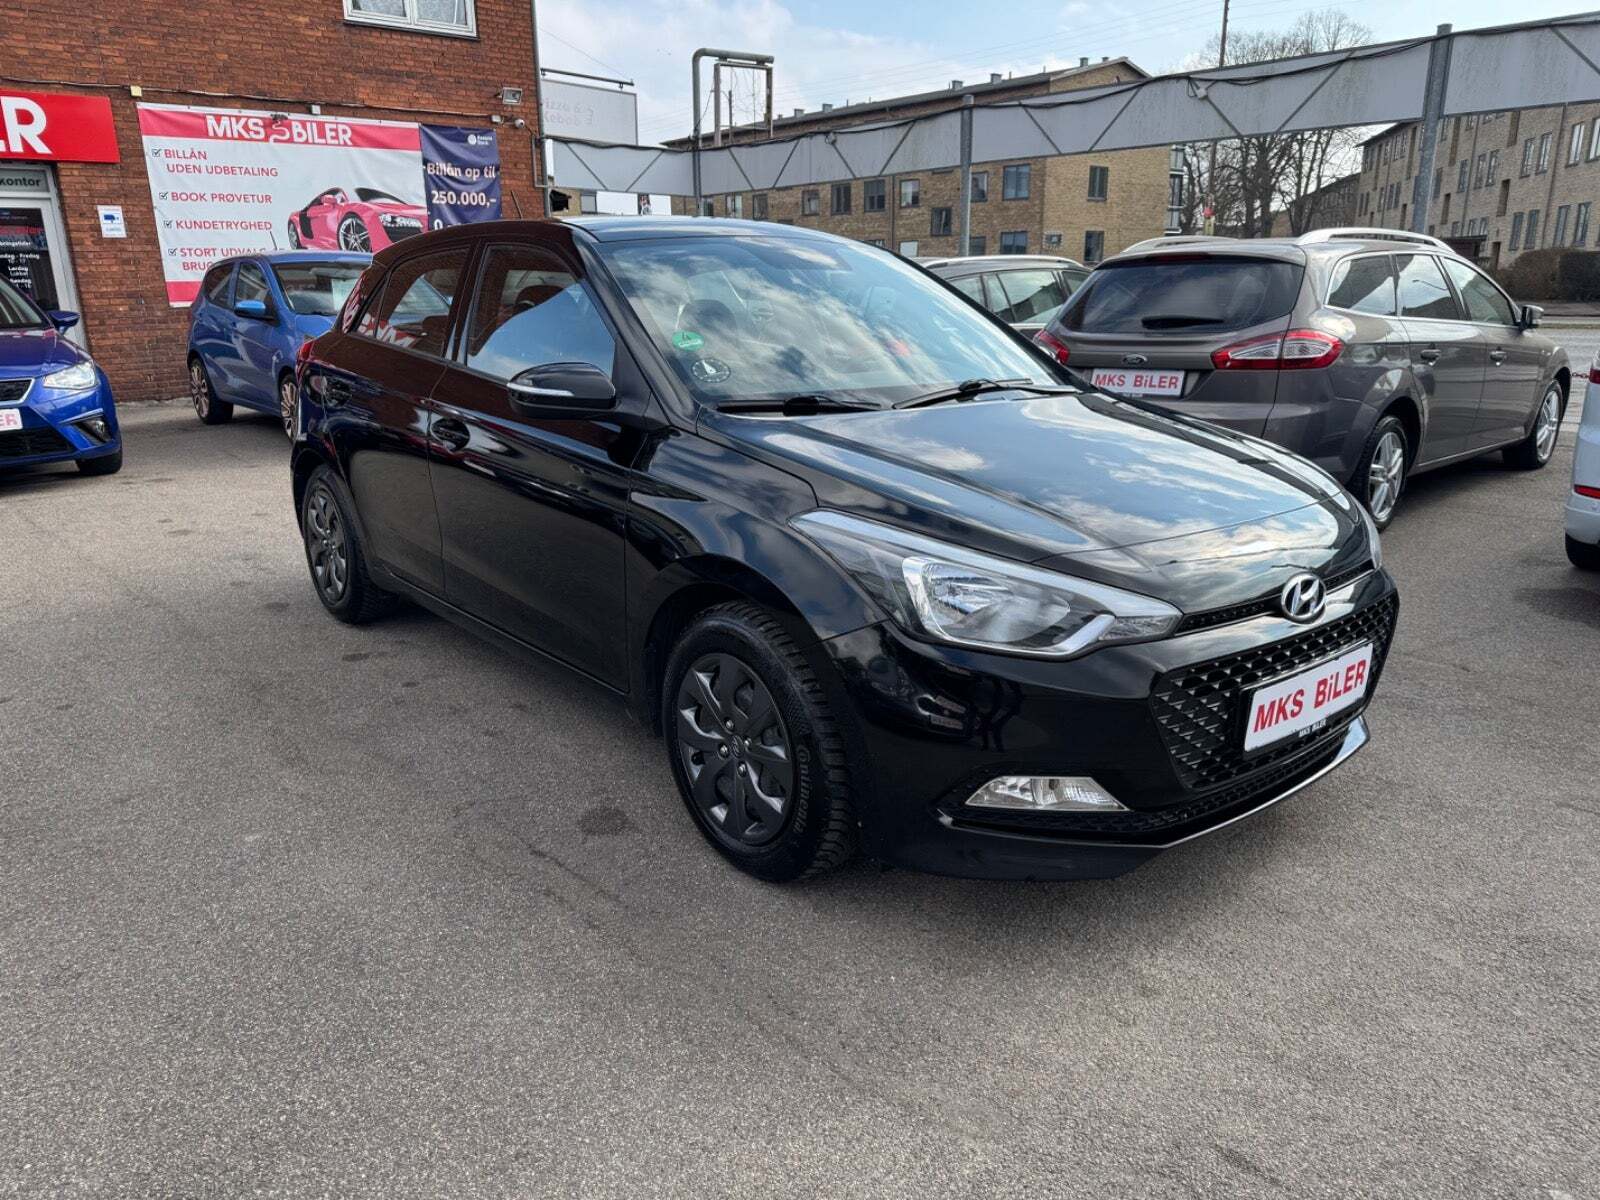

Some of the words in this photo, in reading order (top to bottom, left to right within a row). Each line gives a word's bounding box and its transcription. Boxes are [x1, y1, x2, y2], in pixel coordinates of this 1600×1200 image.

[205, 115, 265, 140] MKS
[291, 121, 353, 146] BILER
[164, 148, 208, 160] BILLÅN
[166, 163, 202, 174] UDEN
[206, 165, 279, 177] UDBETALING
[426, 162, 462, 177] Billån
[464, 167, 480, 181] op
[483, 165, 496, 178] til
[171, 191, 207, 202] BOOK
[211, 194, 272, 204] PRØVETUR
[431, 190, 497, 208] 250.000,-
[175, 220, 272, 231] KUNDETRYGHED
[179, 247, 217, 257] STORT
[1095, 374, 1126, 387] MKS
[1253, 688, 1305, 733] MKS
